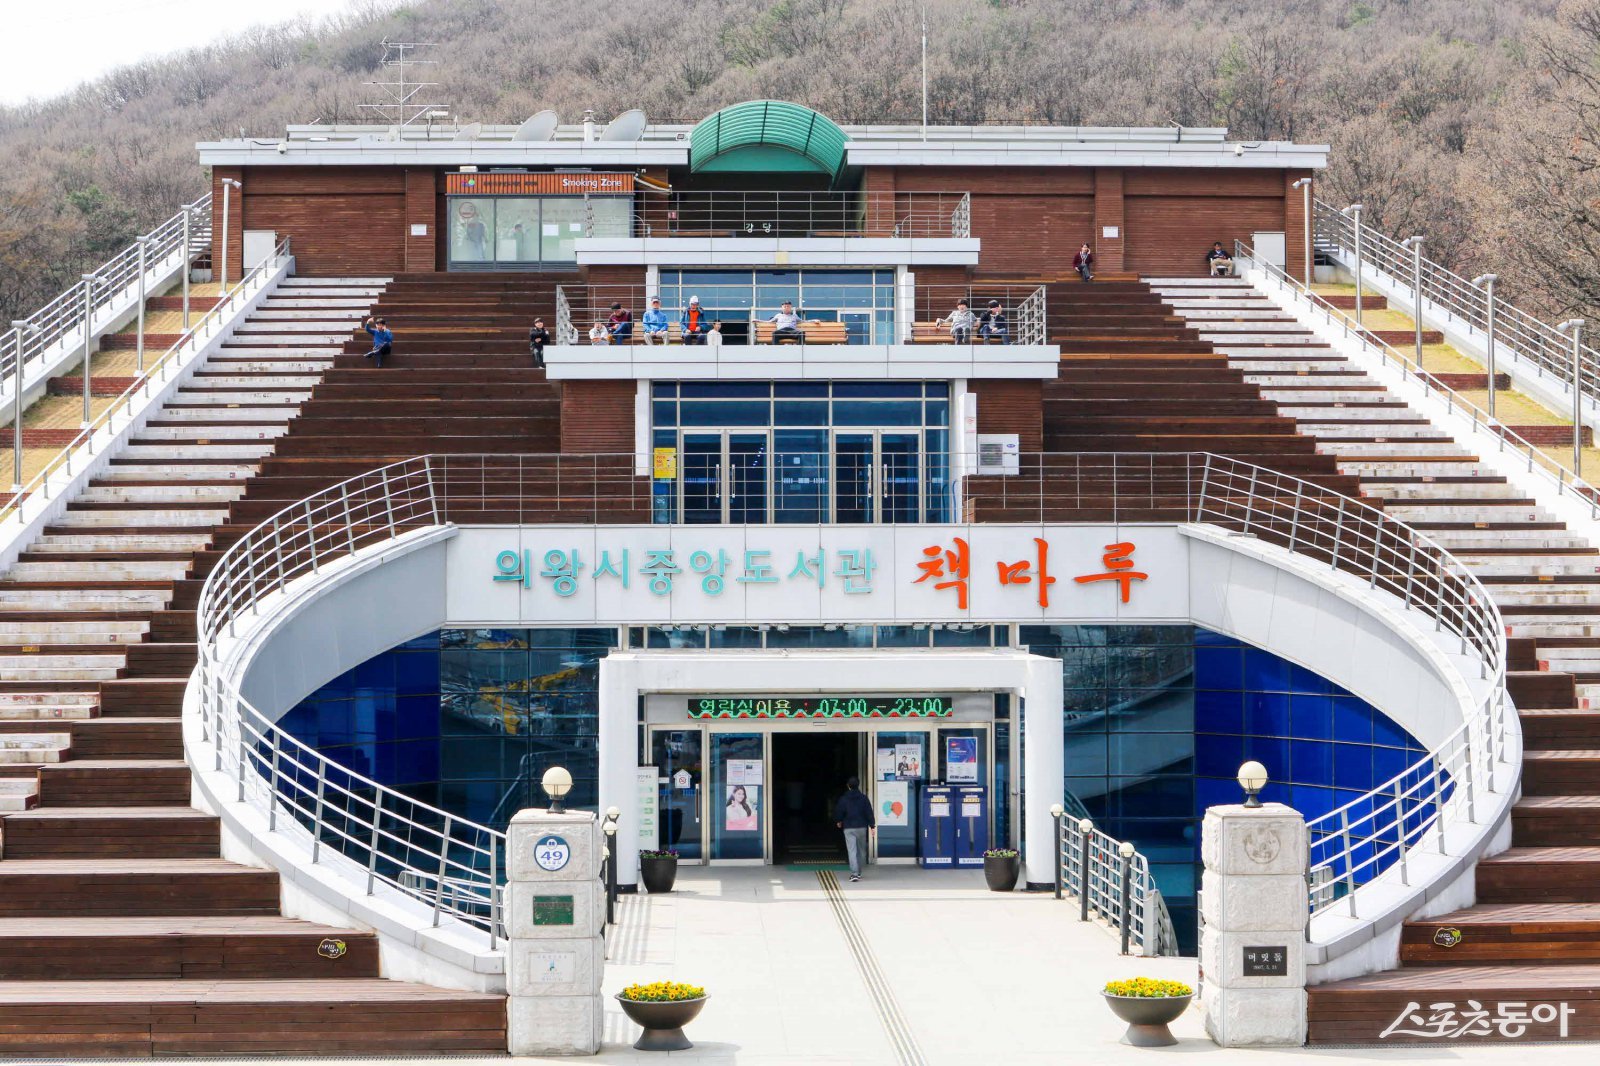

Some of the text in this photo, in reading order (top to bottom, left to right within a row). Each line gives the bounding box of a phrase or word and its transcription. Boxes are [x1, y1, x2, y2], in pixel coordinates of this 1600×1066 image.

[562, 178, 622, 189] Smoking Zone
[914, 537, 1148, 610] 책마루
[819, 698, 867, 714] 07:00
[895, 698, 943, 714] 23:00
[541, 851, 563, 861] 49
